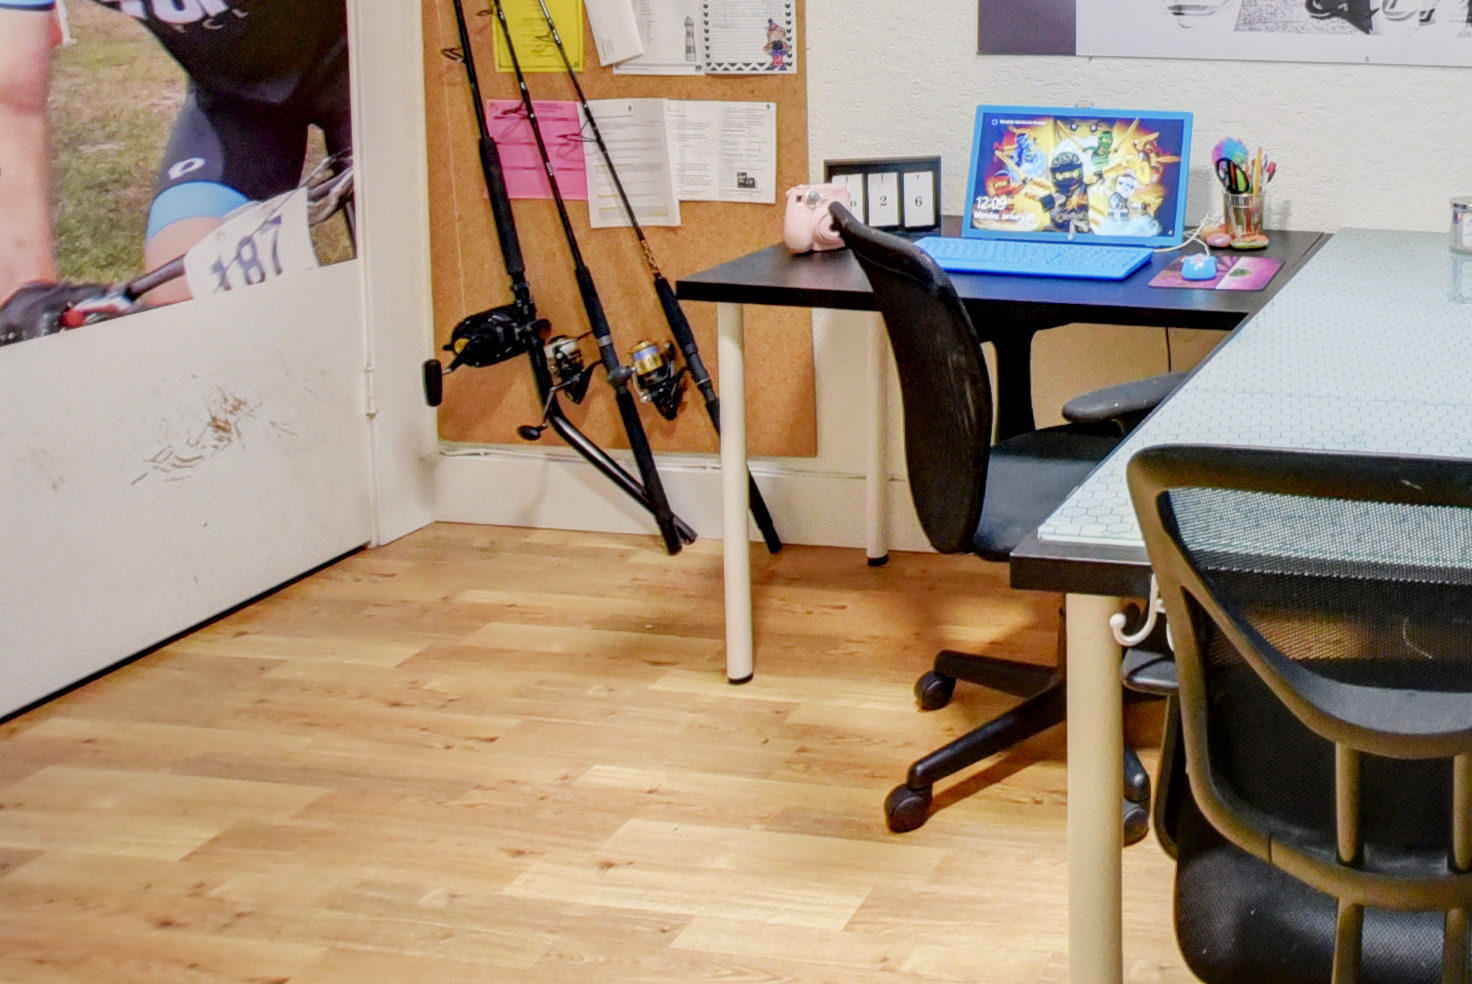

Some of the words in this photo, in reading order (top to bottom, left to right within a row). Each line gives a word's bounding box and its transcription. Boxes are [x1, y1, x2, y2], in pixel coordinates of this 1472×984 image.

[879, 195, 888, 207] 2
[915, 196, 923, 208] 6
[976, 195, 1007, 211] 12:09
